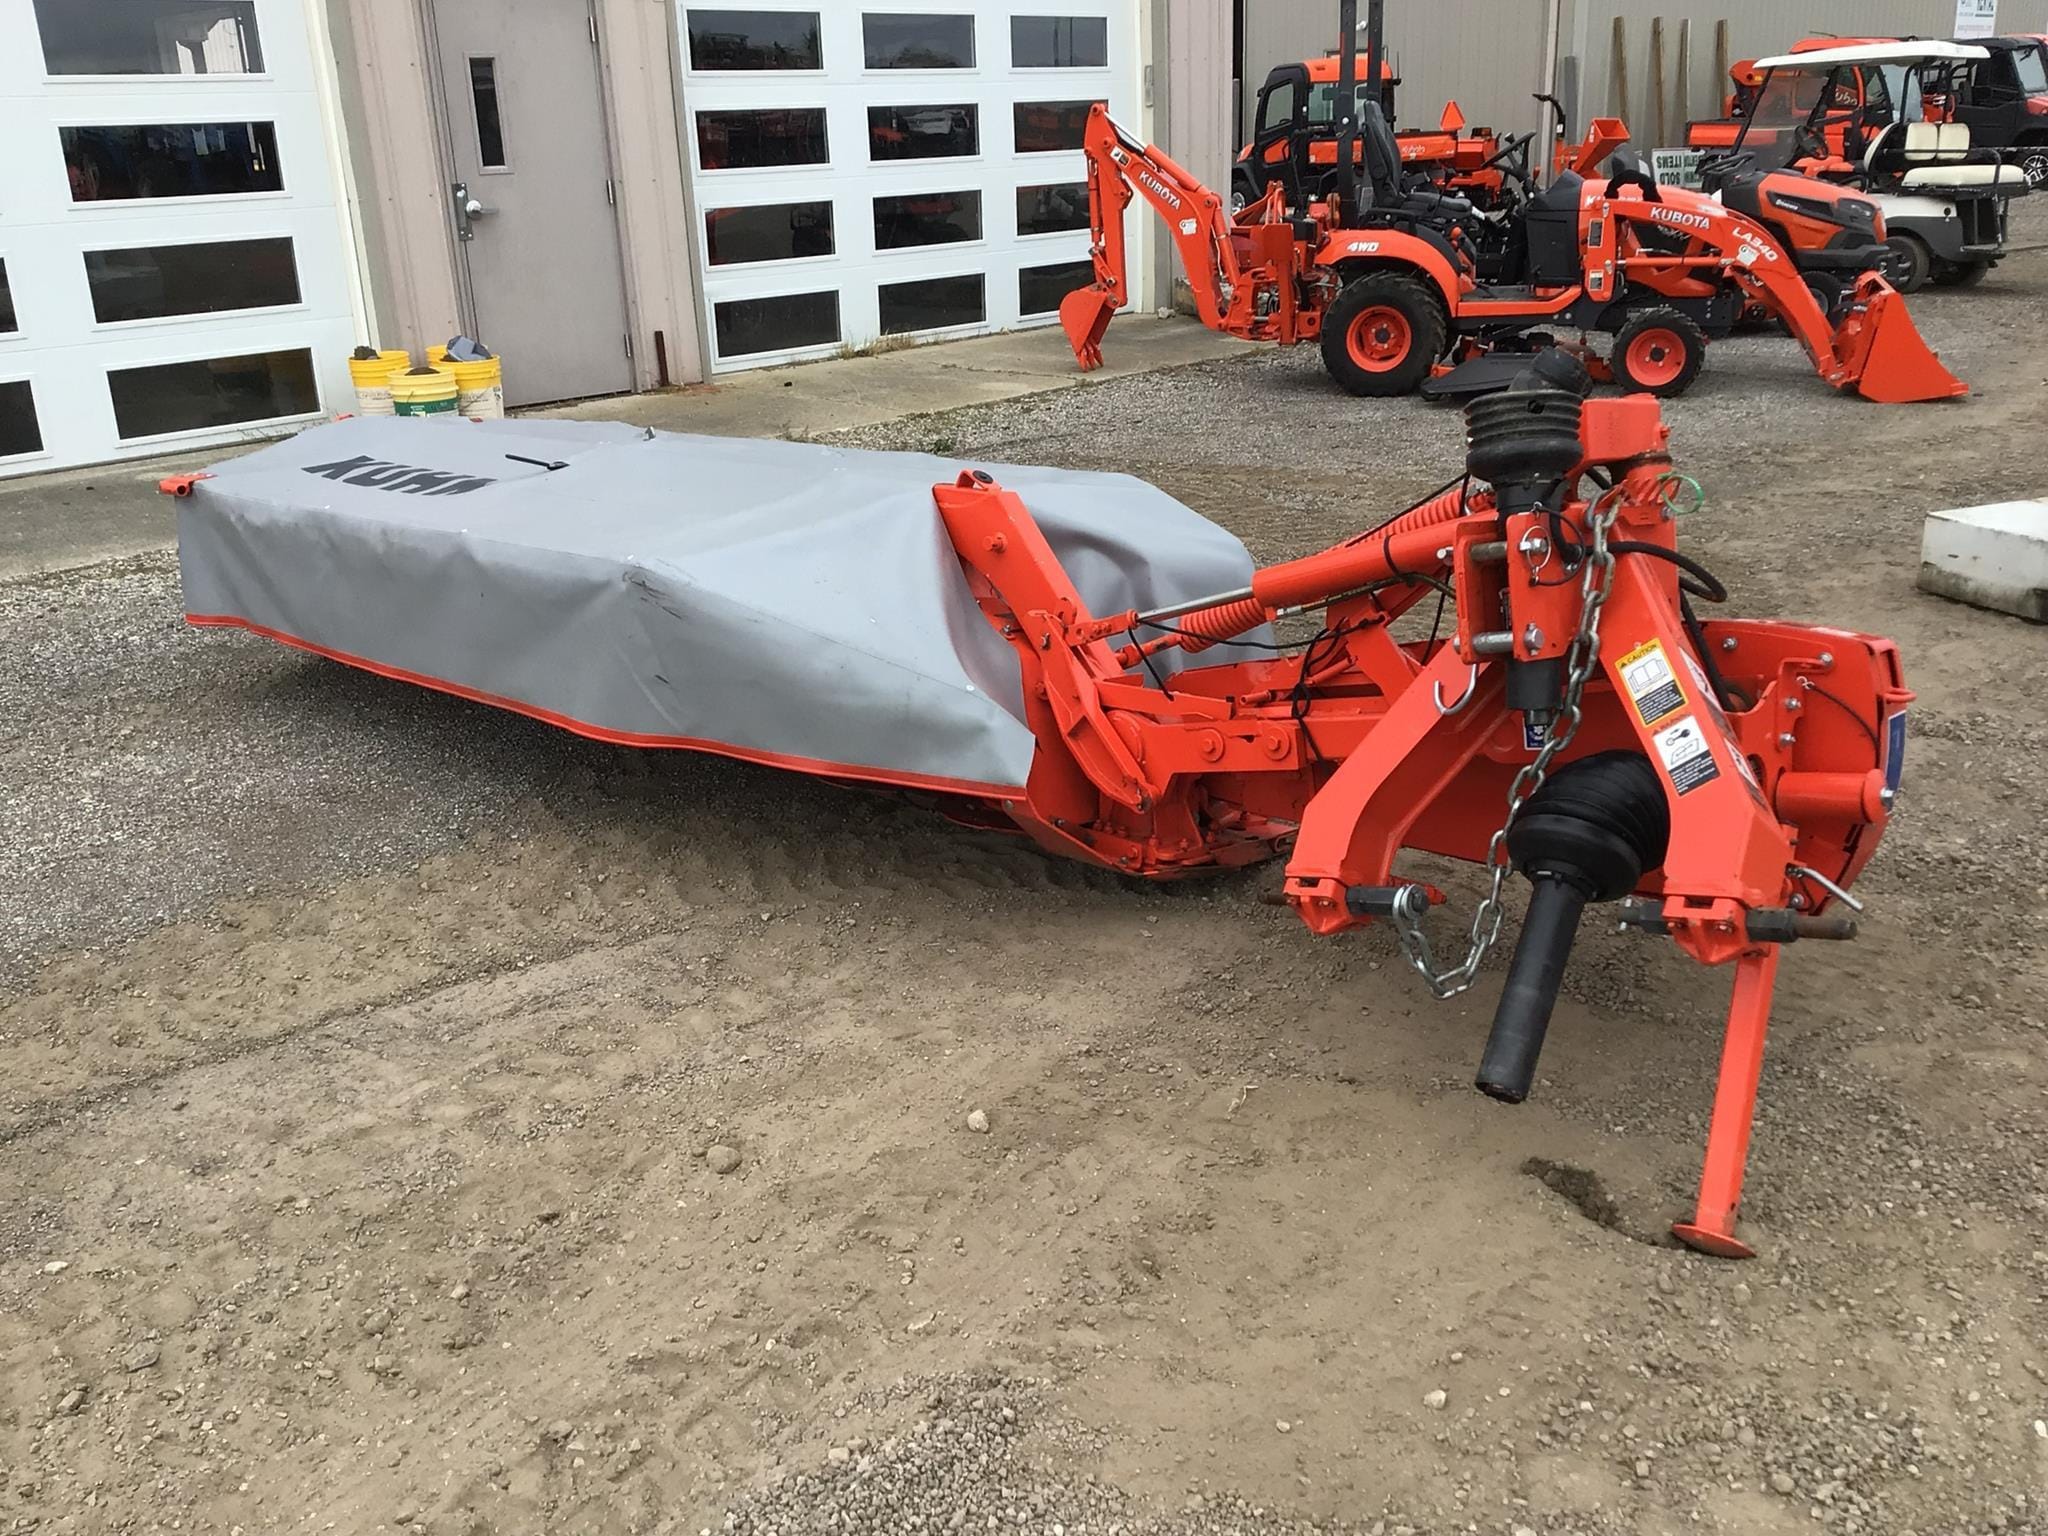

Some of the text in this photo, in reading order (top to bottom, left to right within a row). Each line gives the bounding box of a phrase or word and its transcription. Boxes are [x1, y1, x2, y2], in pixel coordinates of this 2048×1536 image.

[1656, 155, 1682, 169] ITEMS
[1659, 171, 1681, 185] SOLD
[1138, 170, 1182, 211] KUBOTA
[1650, 206, 1712, 230] KUBOTA
[1346, 241, 1380, 252] 4WD
[1731, 226, 1779, 262] LA340
[1627, 643, 1658, 664] CAUTION
